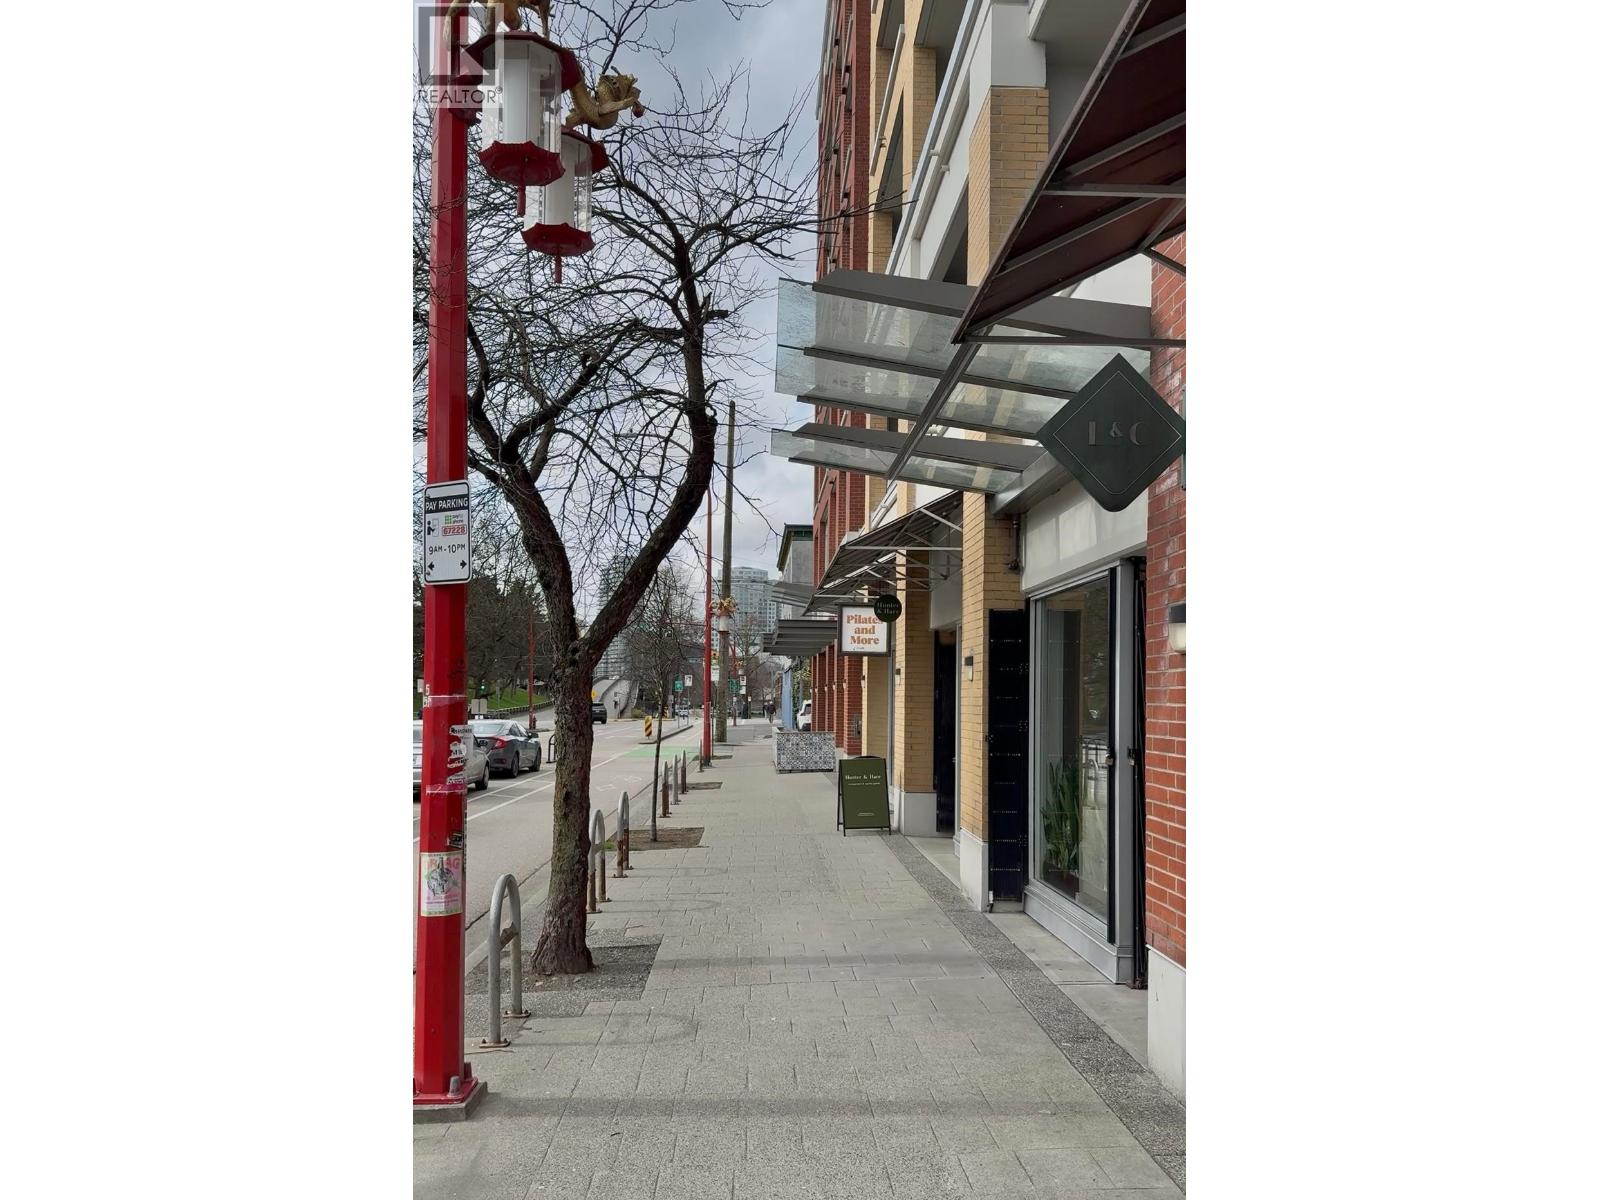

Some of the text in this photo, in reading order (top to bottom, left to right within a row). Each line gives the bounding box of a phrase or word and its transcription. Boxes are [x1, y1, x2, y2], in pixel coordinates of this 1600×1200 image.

[1109, 421, 1124, 438] &
[426, 498, 468, 510] PAY PARKING
[854, 625, 875, 634] and
[850, 636, 879, 644] More
